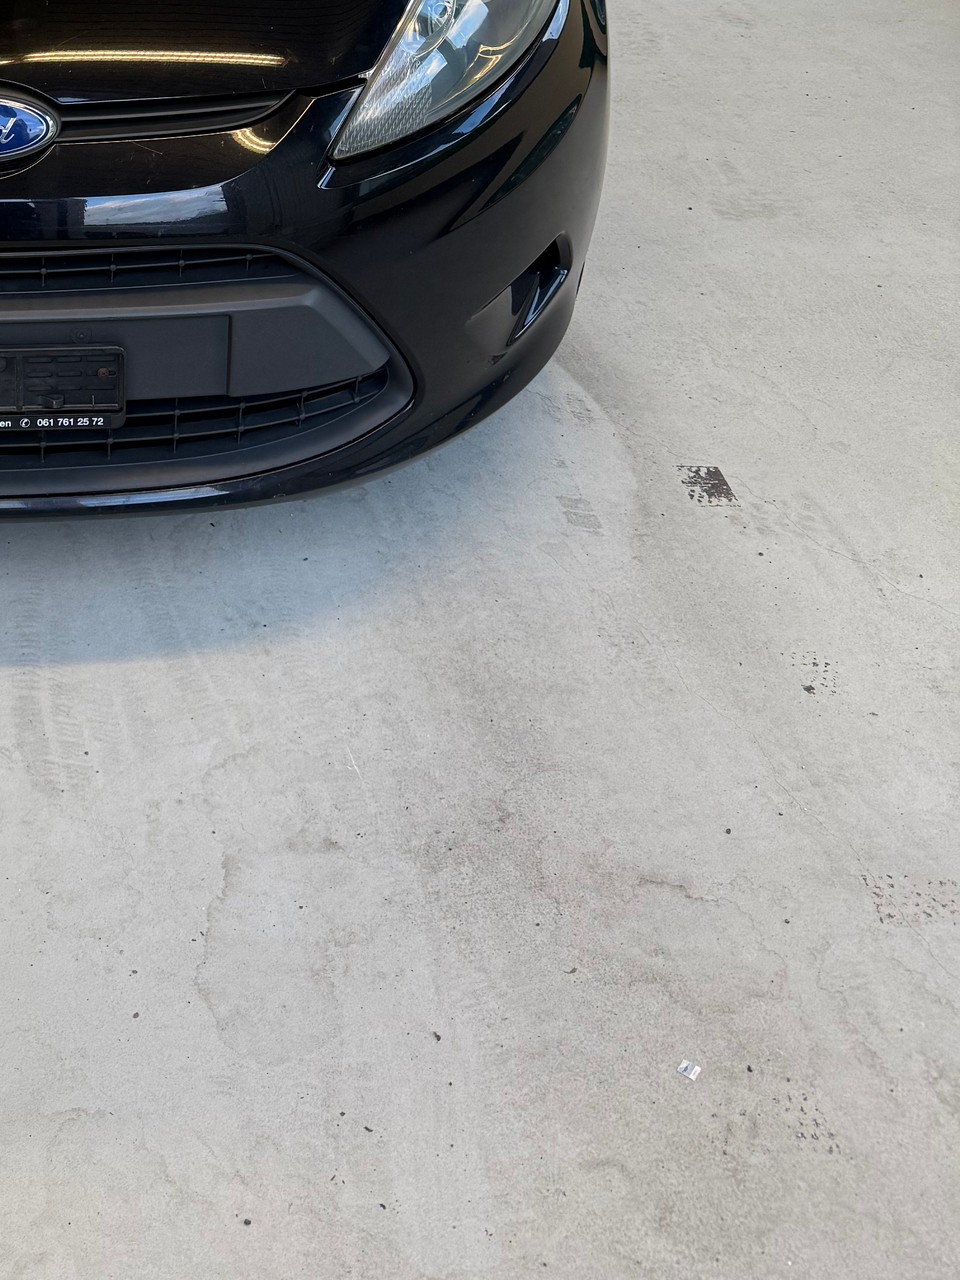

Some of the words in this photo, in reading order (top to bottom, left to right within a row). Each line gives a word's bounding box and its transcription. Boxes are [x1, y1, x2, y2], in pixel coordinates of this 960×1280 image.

[36, 418, 54, 427] 061
[57, 417, 74, 427] 761
[77, 417, 90, 426] 25
[91, 417, 104, 426] 72
